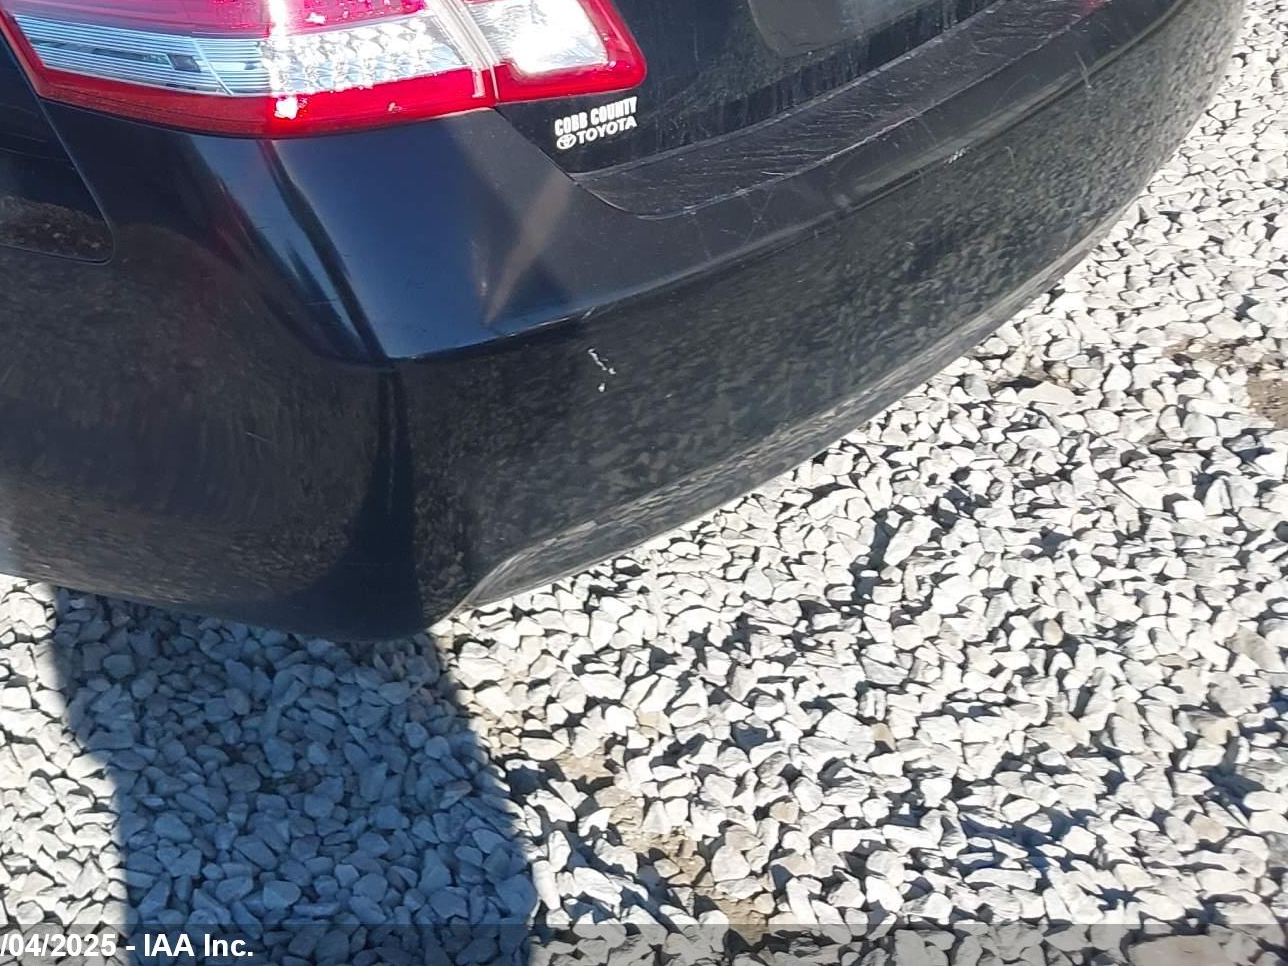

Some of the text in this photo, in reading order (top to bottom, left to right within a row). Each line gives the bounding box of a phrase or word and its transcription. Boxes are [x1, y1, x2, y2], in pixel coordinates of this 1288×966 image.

[554, 96, 638, 137] COBB COUNTY
[576, 115, 638, 145] TOYOTA
